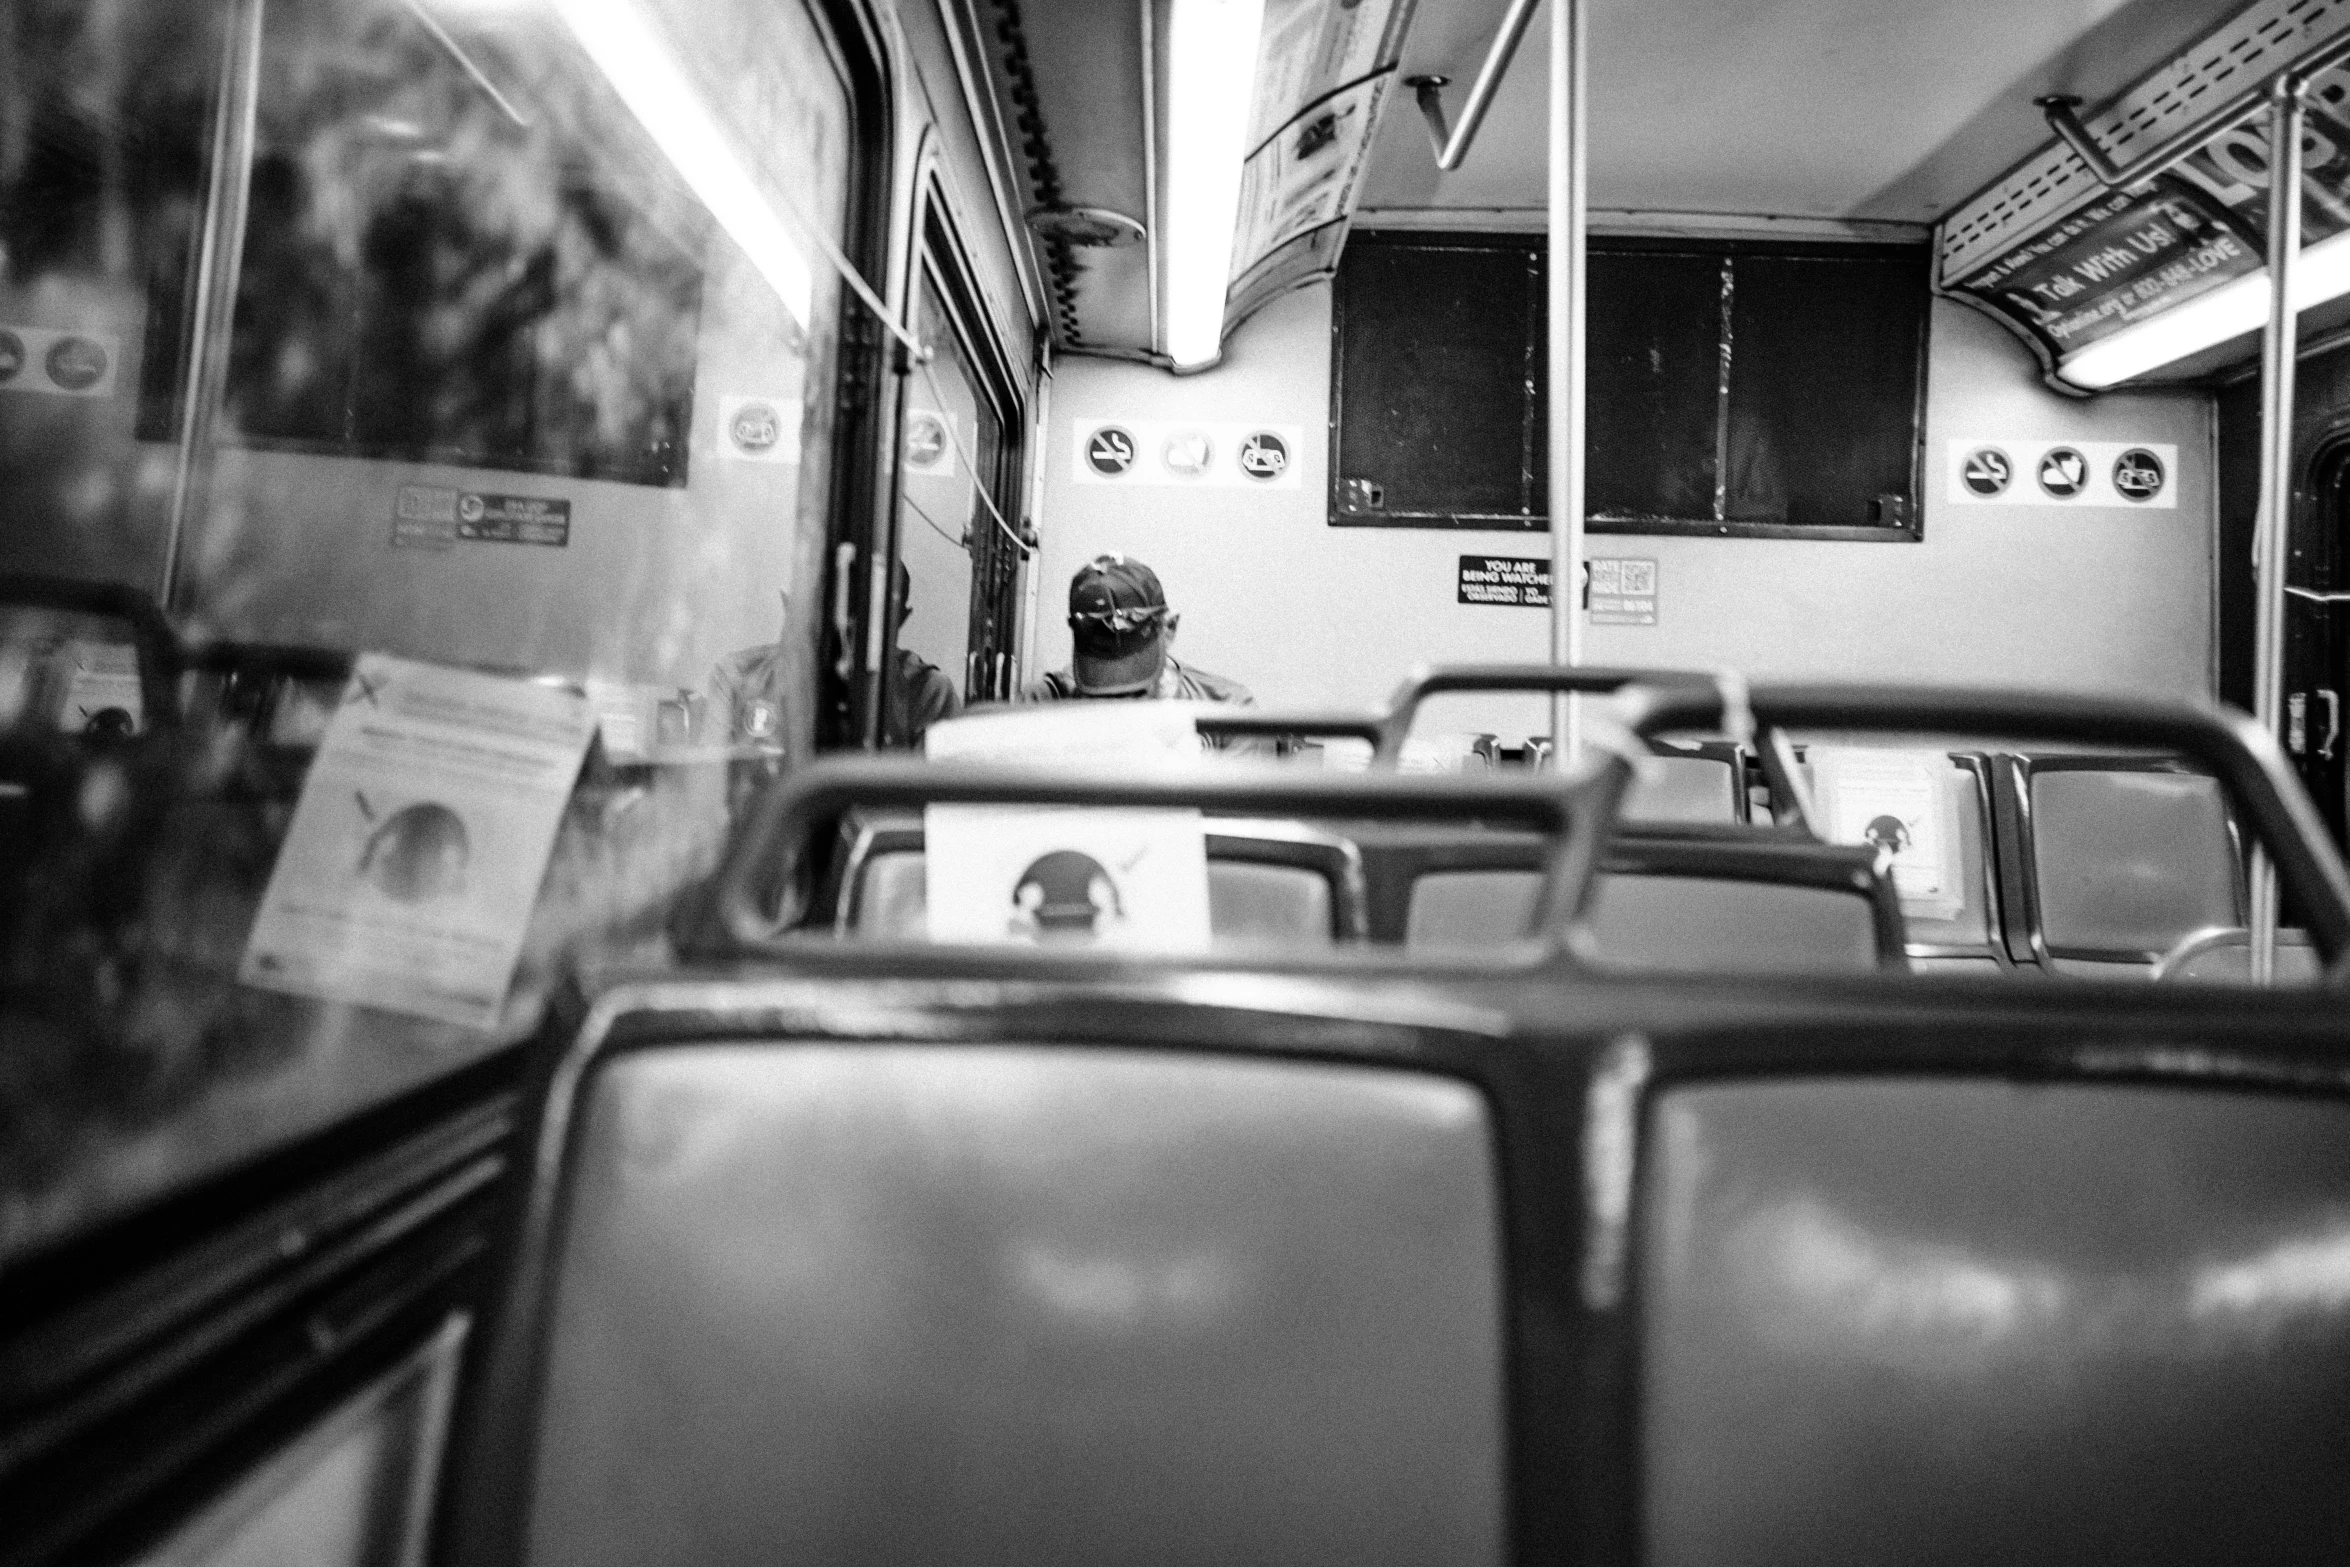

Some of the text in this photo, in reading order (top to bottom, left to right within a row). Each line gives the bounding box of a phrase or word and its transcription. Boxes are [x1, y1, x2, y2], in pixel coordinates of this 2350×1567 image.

[2032, 275, 2086, 301] Talk
[2072, 246, 2140, 282] With
[1484, 560, 1537, 574] YOU ARE
[1462, 569, 1500, 583] BEING
